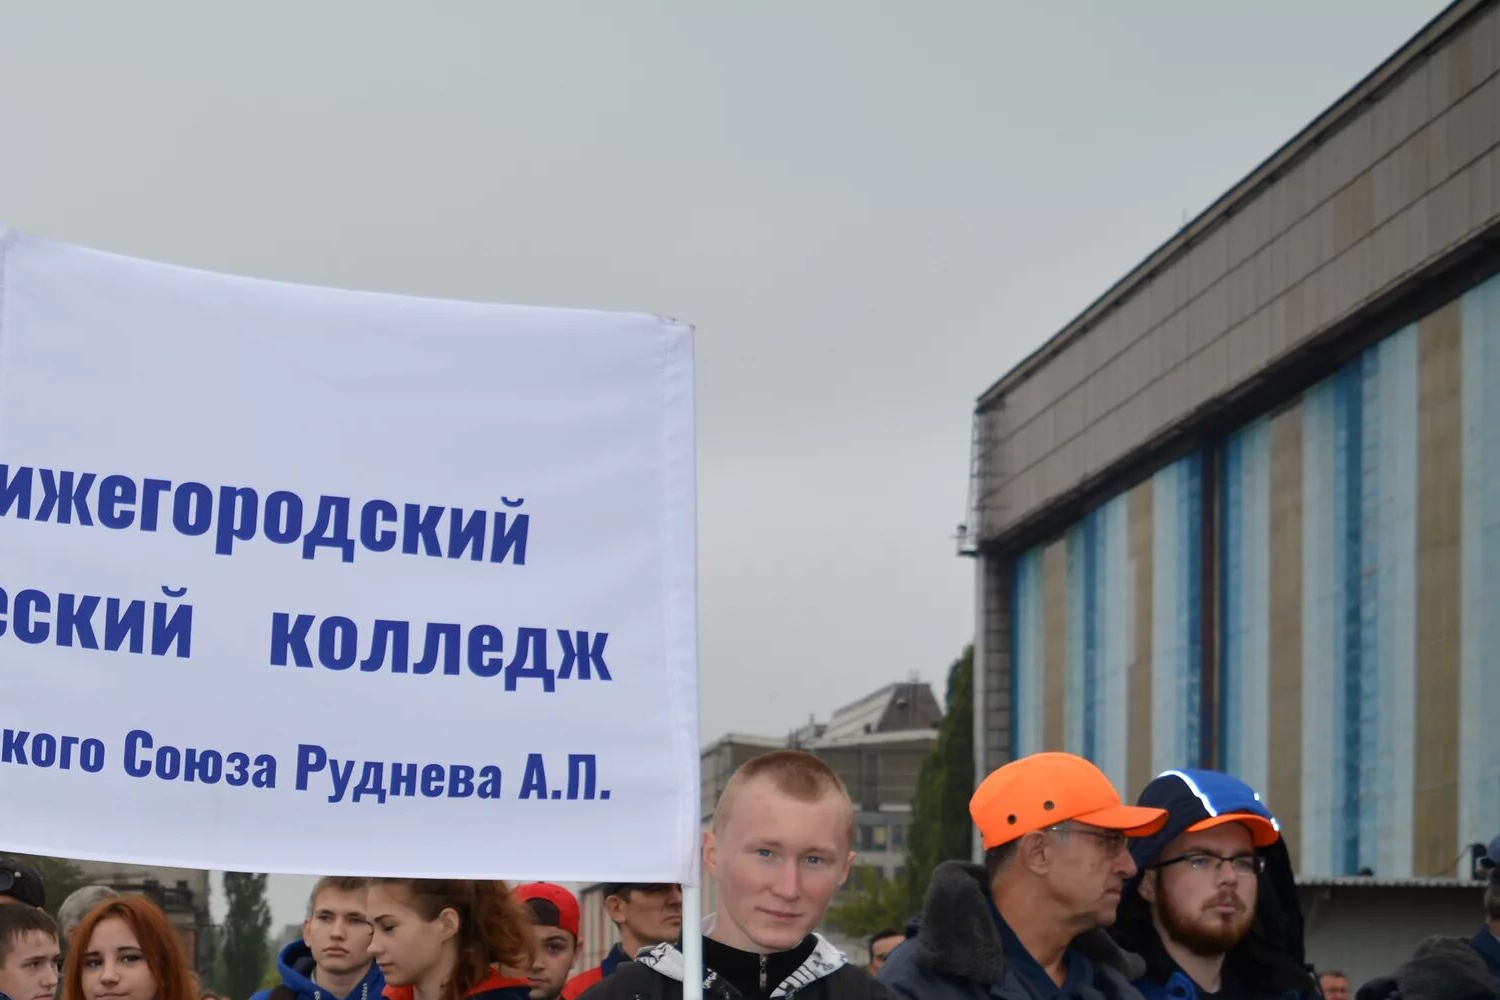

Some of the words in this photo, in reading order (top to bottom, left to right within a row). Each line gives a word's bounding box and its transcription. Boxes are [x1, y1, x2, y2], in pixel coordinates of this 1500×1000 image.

[270, 612, 612, 692] колледж
[124, 729, 277, 788] Союза
[296, 744, 502, 804] Руднева
[518, 754, 611, 801] А.П.
